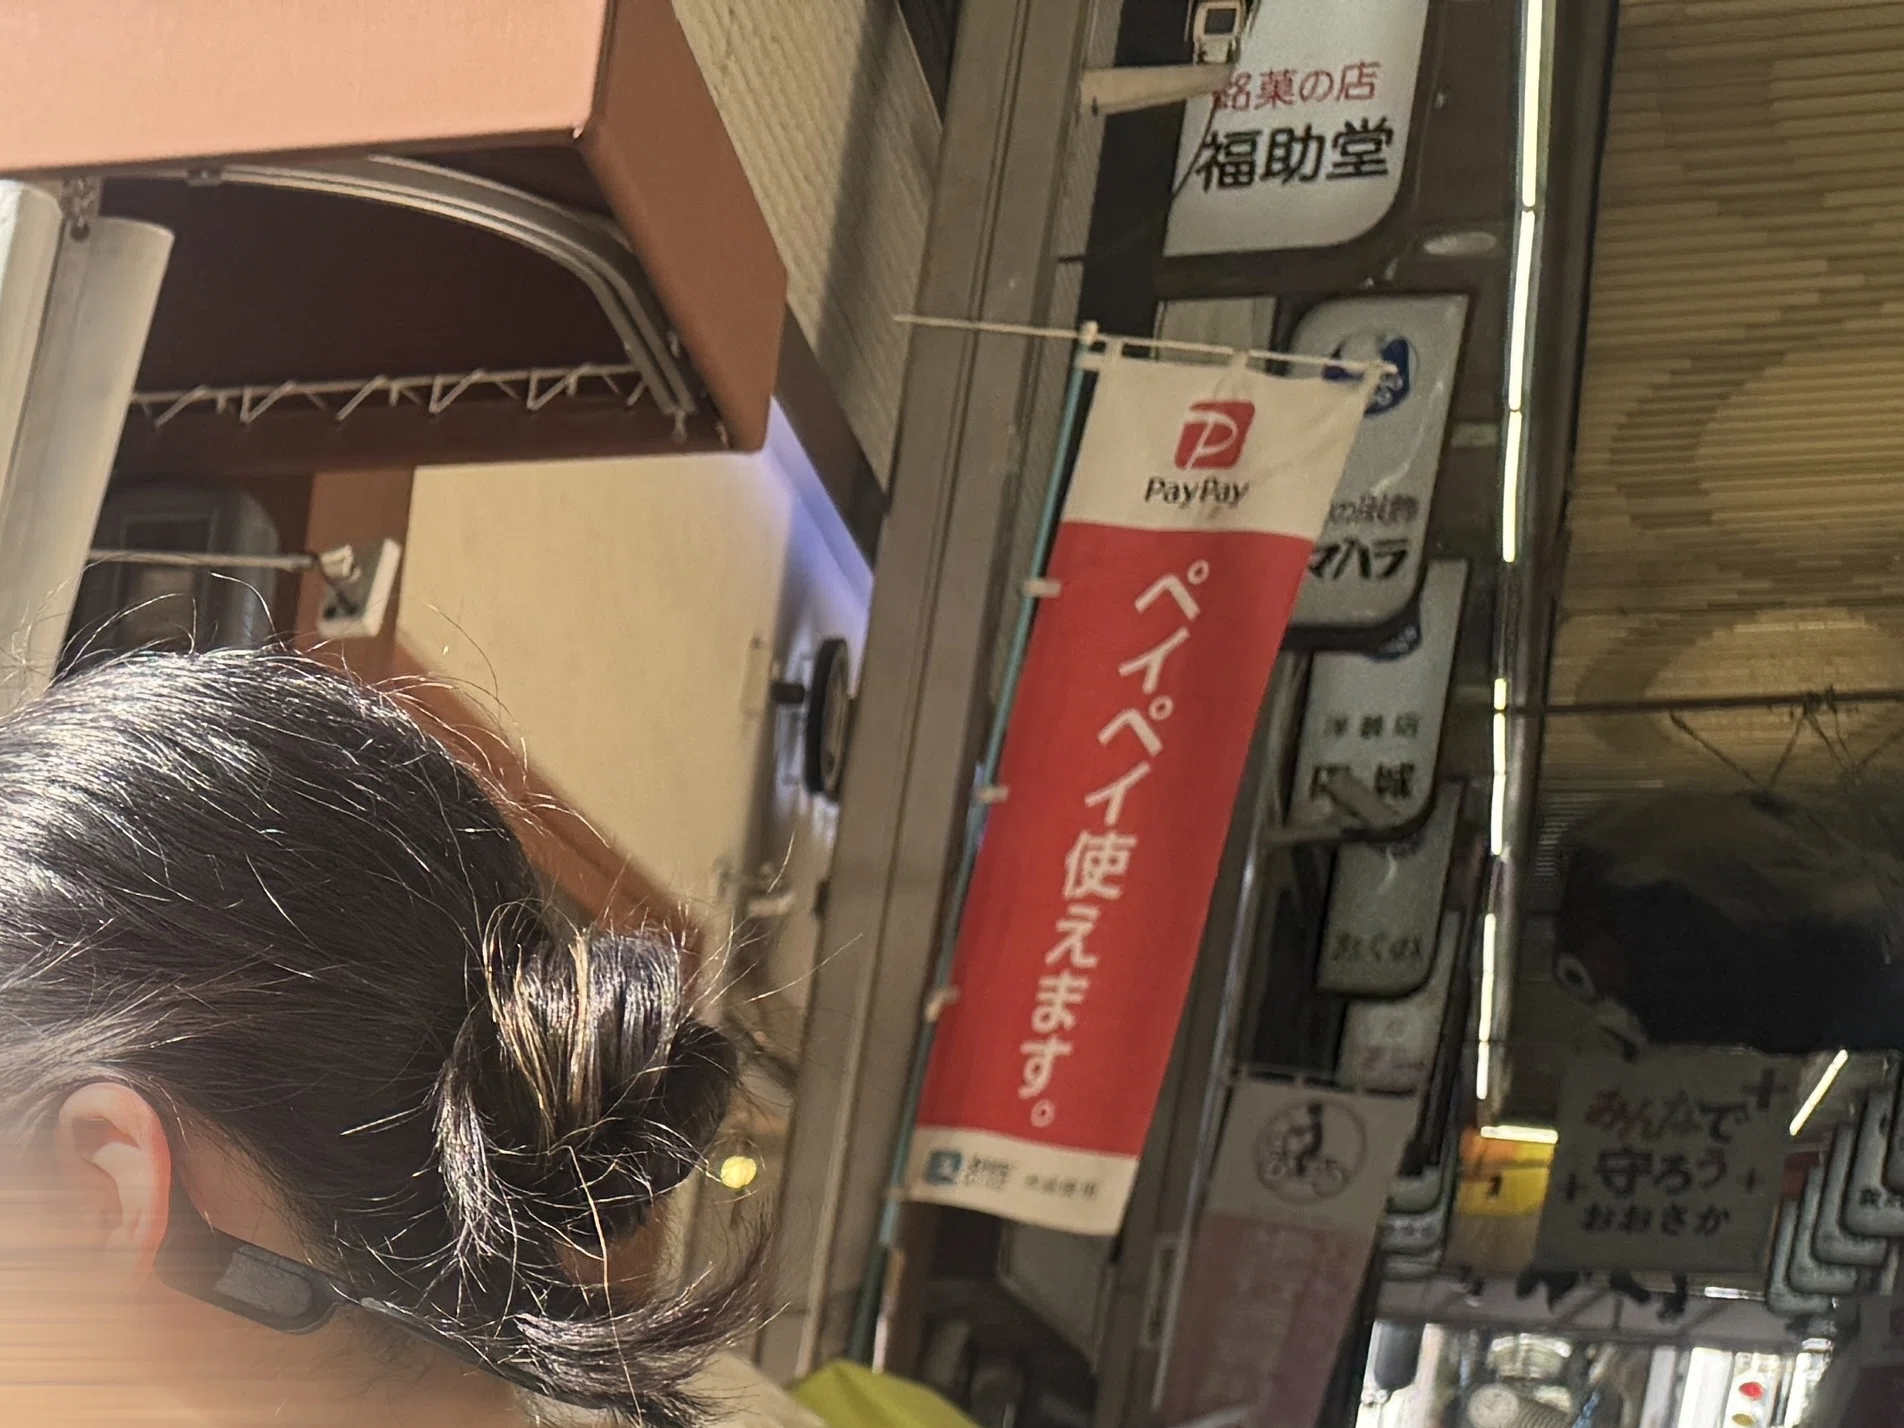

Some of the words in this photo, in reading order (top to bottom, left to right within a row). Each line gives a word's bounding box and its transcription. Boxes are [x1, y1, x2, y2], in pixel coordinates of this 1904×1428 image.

[1195, 115, 1394, 193] 福助堂
[1144, 475, 1250, 510] PayPay
[1018, 560, 1210, 1127] ペイペイ使えます。
[1581, 1204, 1730, 1236] おおさか
